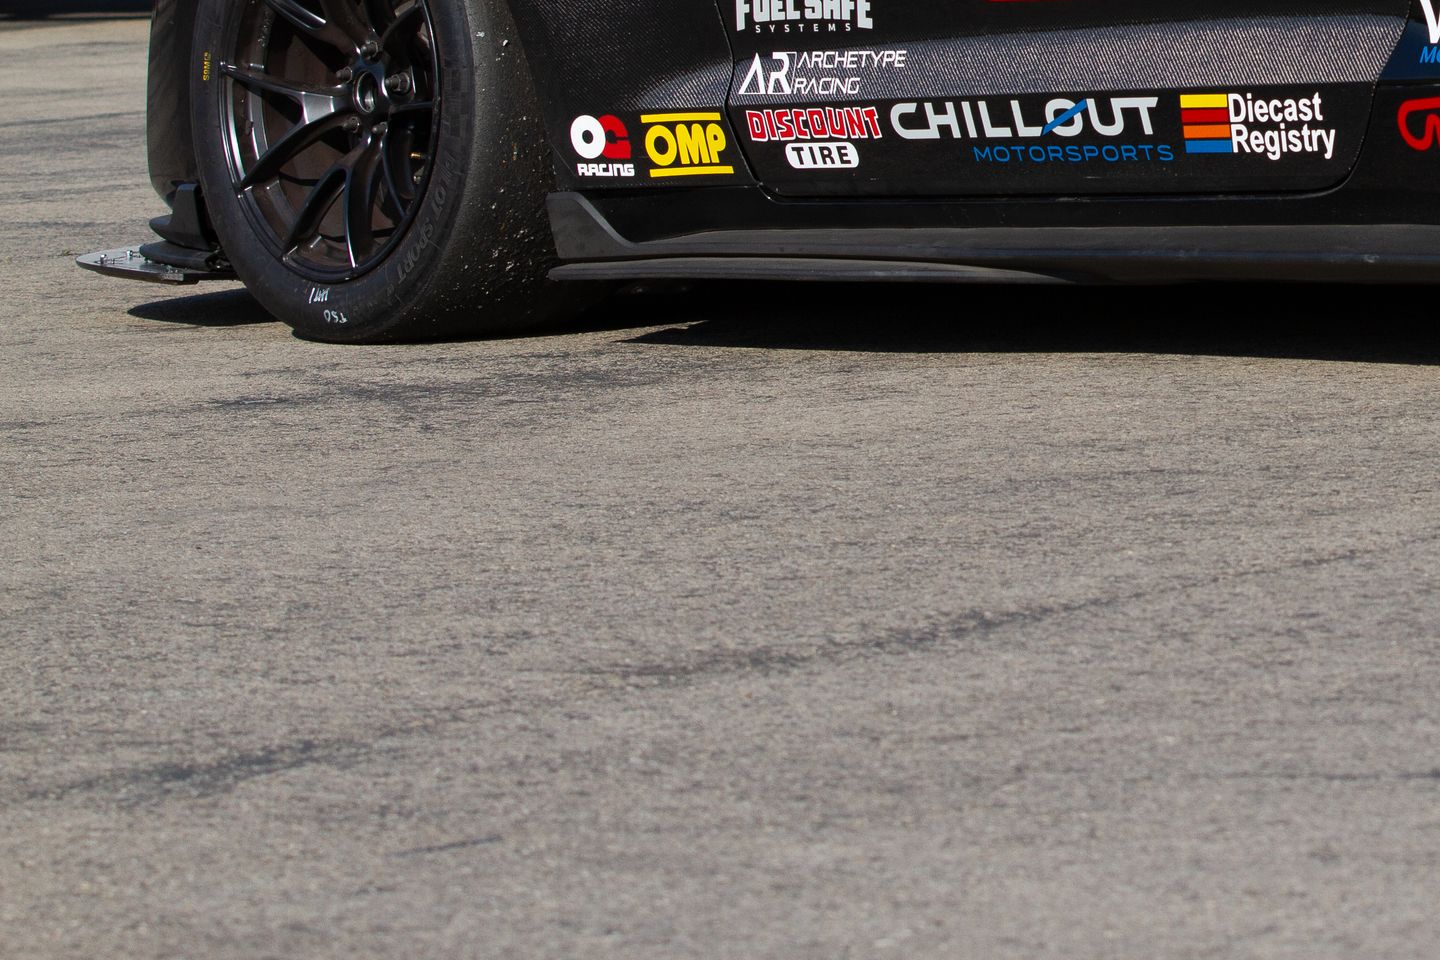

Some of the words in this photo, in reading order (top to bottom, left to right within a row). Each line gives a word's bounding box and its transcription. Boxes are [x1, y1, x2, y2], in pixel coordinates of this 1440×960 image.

[755, 22, 852, 33] SYSTEMS
[797, 51, 907, 68] ARCHETYPE
[793, 78, 860, 94] RACING
[1227, 92, 1324, 123] Diecast
[746, 106, 882, 142] DISCOUNT
[890, 96, 1159, 140] CHILLOUT
[645, 123, 727, 166] OMP
[1230, 123, 1336, 160] Registry
[791, 146, 853, 166] TIRE
[973, 144, 1175, 162] MOTORSPORTS
[577, 163, 635, 176] RACING
